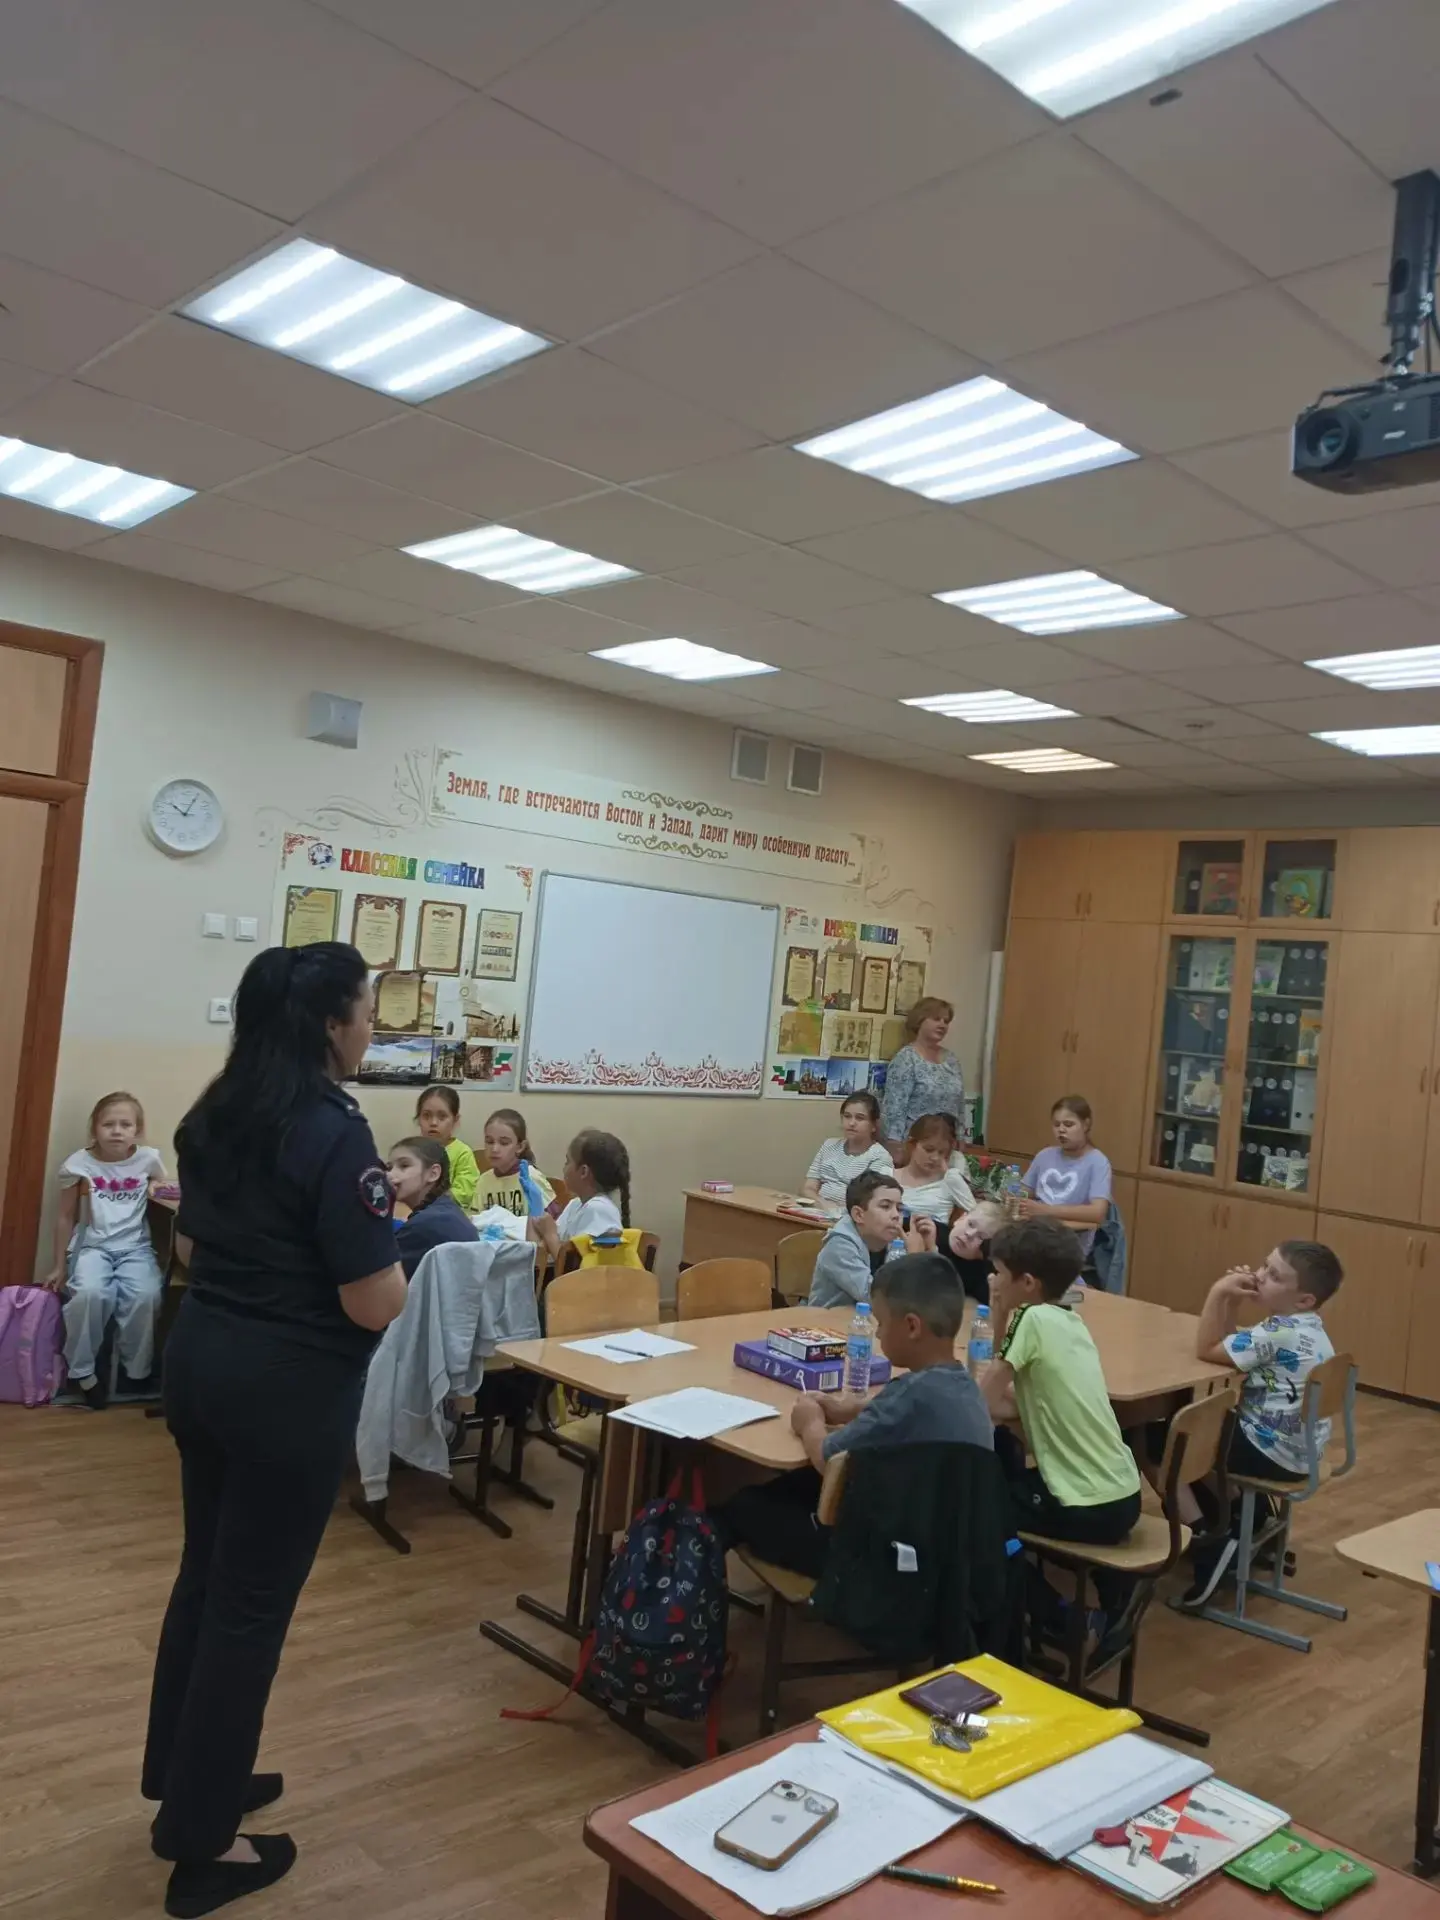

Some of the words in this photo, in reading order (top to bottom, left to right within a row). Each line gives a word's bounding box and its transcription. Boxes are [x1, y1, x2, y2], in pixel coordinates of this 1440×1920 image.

[447, 771, 491, 801] Земля,
[498, 784, 520, 805] где
[525, 790, 600, 819] встречаются
[605, 802, 644, 828] Восток
[648, 813, 656, 830] и
[661, 812, 694, 839] Запад,
[699, 823, 729, 844] дарит
[733, 829, 758, 850] миру
[762, 835, 811, 859] особенную
[814, 844, 856, 866] красоту...
[340, 847, 418, 881] КЛАССНАЯ
[424, 859, 485, 889] СЕМЕЙКА
